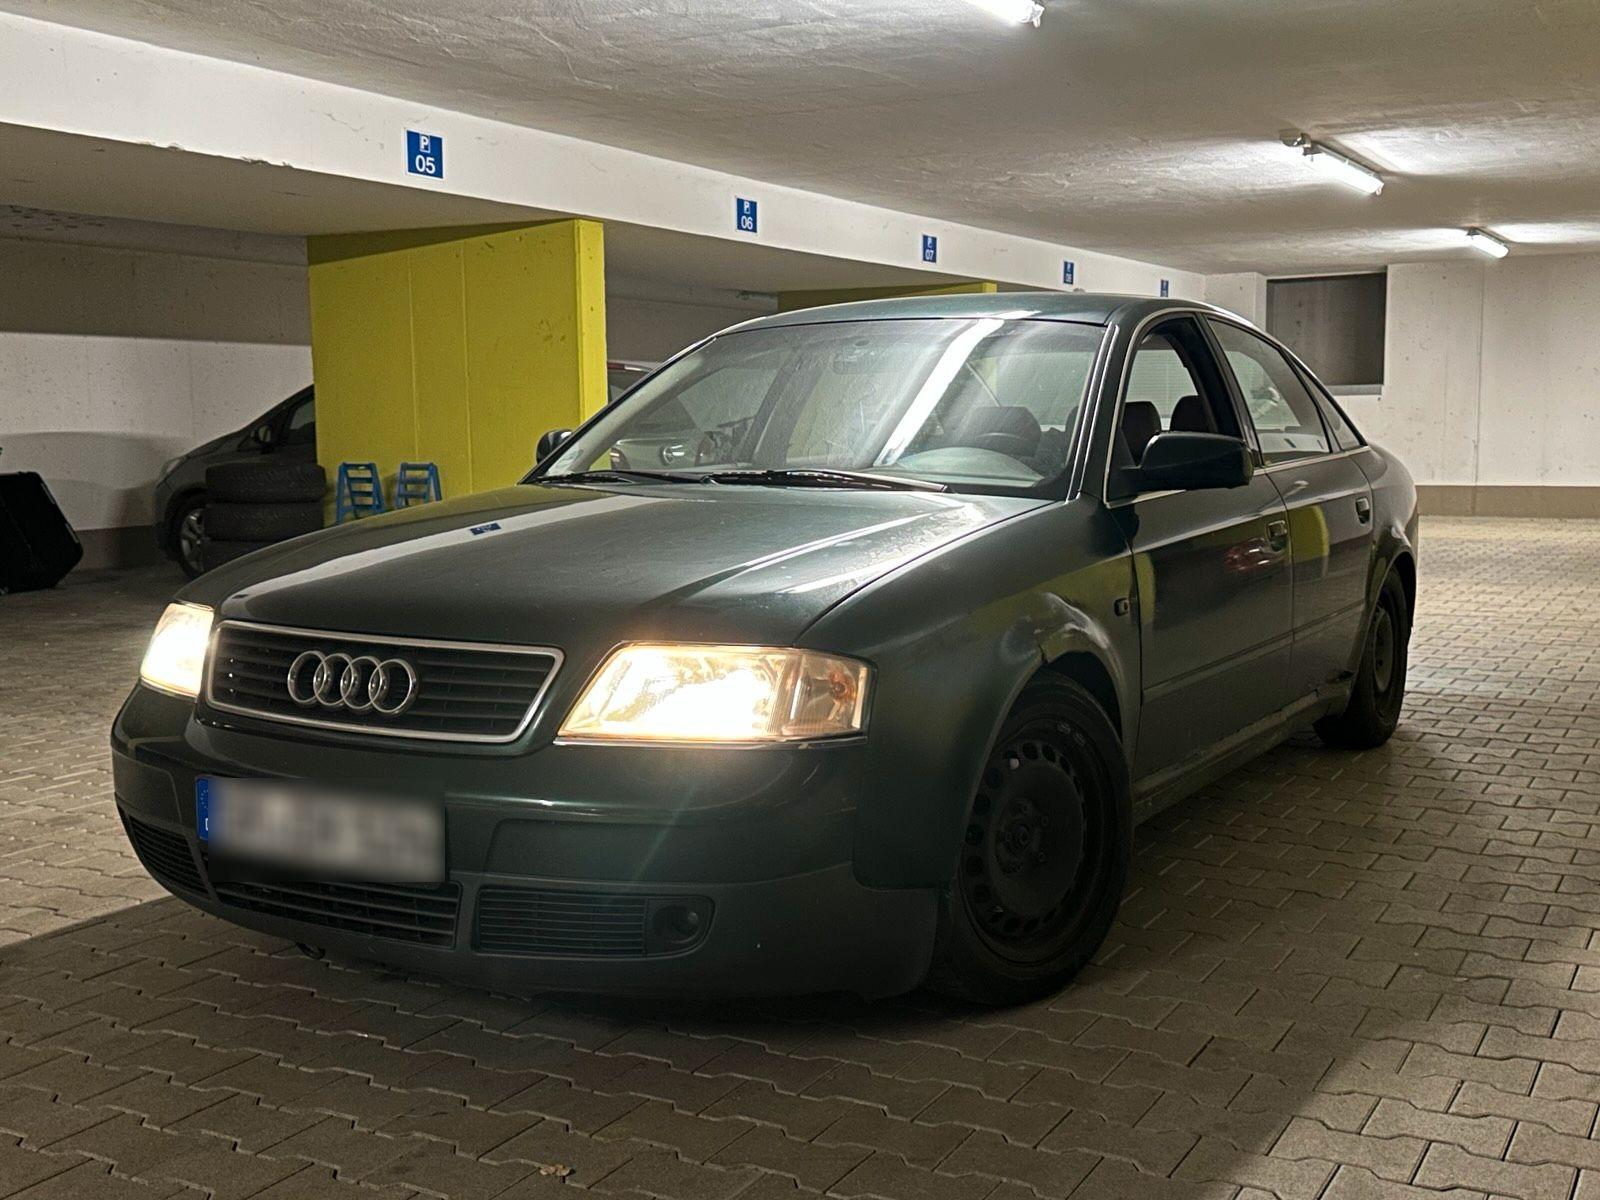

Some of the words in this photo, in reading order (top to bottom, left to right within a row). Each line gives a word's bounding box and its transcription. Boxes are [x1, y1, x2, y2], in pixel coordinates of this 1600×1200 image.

[421, 135, 429, 149] P
[415, 154, 436, 174] 05
[744, 201, 750, 213] P
[741, 215, 753, 230] 06
[925, 249, 934, 261] 07
